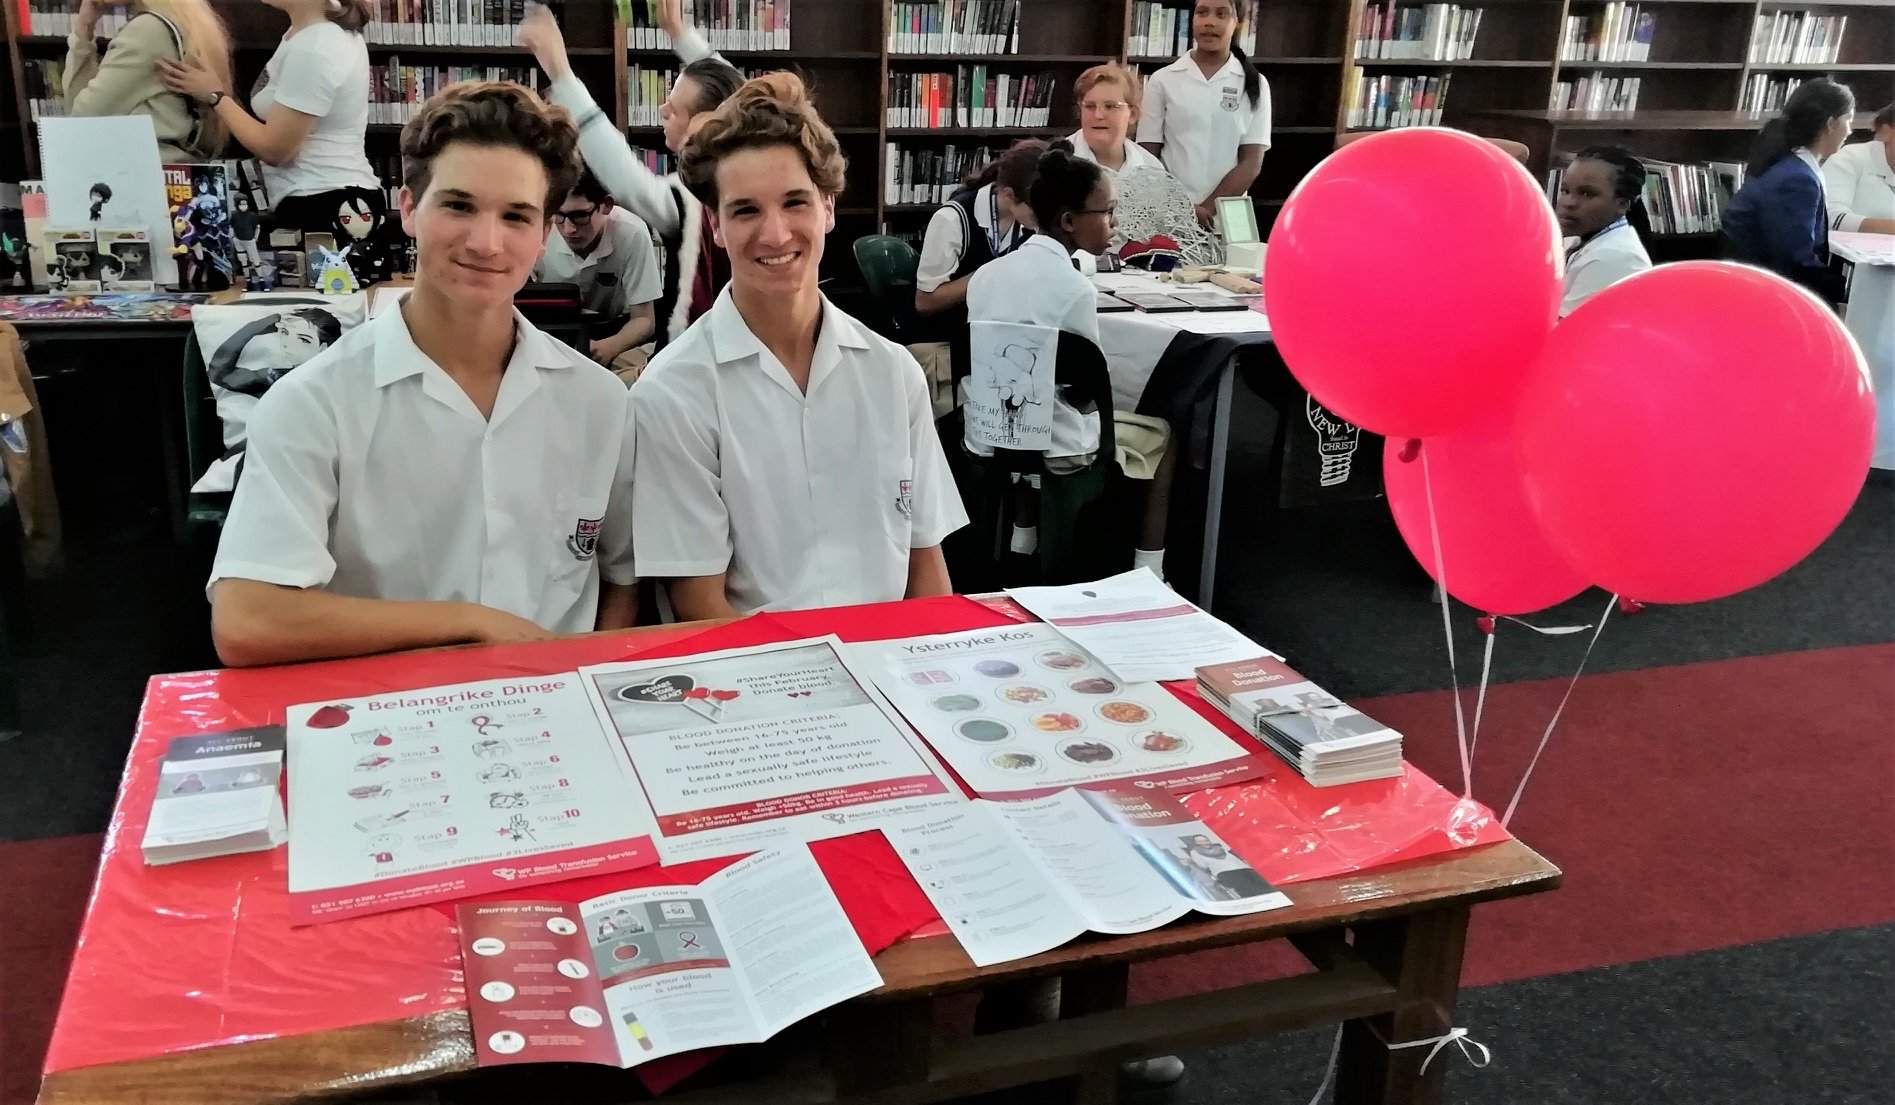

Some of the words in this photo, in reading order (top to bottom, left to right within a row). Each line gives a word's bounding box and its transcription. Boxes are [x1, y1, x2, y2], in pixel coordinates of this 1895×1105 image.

[1310, 406, 1342, 436] NEW
[1321, 441, 1356, 451] CHRIST
[902, 637, 995, 654] Ysterryke
[999, 631, 1034, 642] Kos
[736, 665, 835, 684] #ShareYourHeart
[1232, 669, 1267, 679] Blood
[750, 679, 773, 689] this
[1232, 675, 1284, 687] Donation
[368, 689, 494, 711] Belangrike
[502, 681, 566, 697] Dinge
[752, 685, 796, 696] Donate
[416, 707, 441, 716] om
[448, 704, 464, 713] te
[470, 697, 527, 711] onthou
[532, 707, 542, 715] 2
[540, 730, 551, 738] 4
[668, 729, 712, 741] BLOOD
[715, 720, 779, 736] DONATION
[674, 743, 691, 751] Be
[694, 735, 750, 749] between
[793, 726, 827, 737] years
[829, 721, 848, 729] old
[195, 741, 262, 753] Anaemia
[429, 745, 440, 754] 3
[705, 746, 744, 758] Weigh
[764, 738, 796, 748] least
[798, 734, 814, 742] 50
[816, 733, 832, 743] kg
[549, 754, 560, 764] 6
[686, 758, 735, 772] healthy
[760, 751, 781, 760] the
[785, 747, 806, 758] day
[809, 744, 825, 752] of
[827, 737, 881, 749] donation
[688, 773, 721, 783] Lead
[736, 762, 789, 776] sexually
[792, 756, 818, 767] safe
[821, 750, 873, 763] lifestyle
[430, 770, 441, 779] 5
[558, 777, 570, 787] 8
[682, 788, 698, 797] Be
[703, 776, 775, 793] committed
[796, 765, 844, 779] helping
[440, 794, 451, 803] 7
[756, 798, 783, 808] BLOOD
[563, 808, 581, 819] 10
[714, 812, 735, 822] years
[446, 826, 458, 836] 9
[606, 850, 638, 862] Service
[476, 906, 519, 914] Journey
[534, 905, 563, 913] Blood
